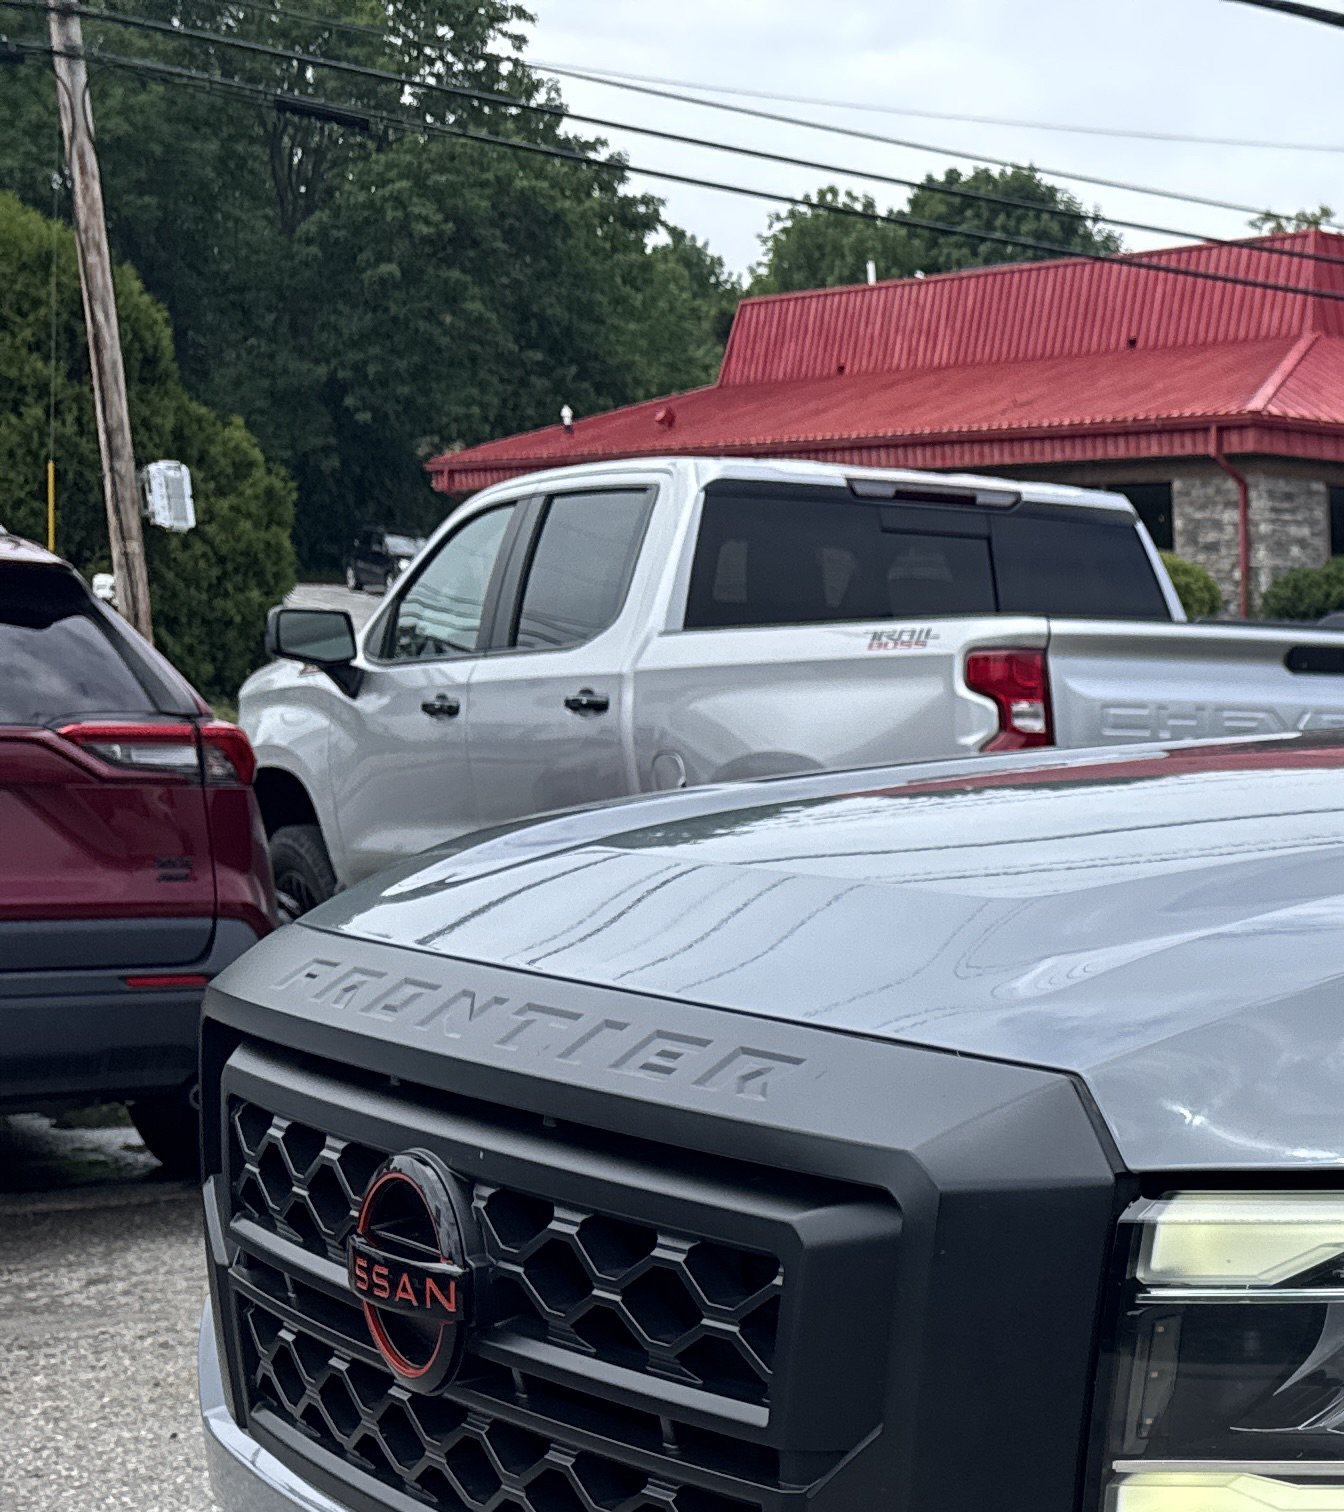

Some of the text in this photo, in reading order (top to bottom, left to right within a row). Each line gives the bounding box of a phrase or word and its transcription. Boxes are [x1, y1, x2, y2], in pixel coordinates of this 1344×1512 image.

[864, 628, 940, 641] TRAIL
[868, 640, 927, 650] BOSS
[271, 957, 807, 1100] FRONTIER
[355, 1257, 457, 1313] SSAN
